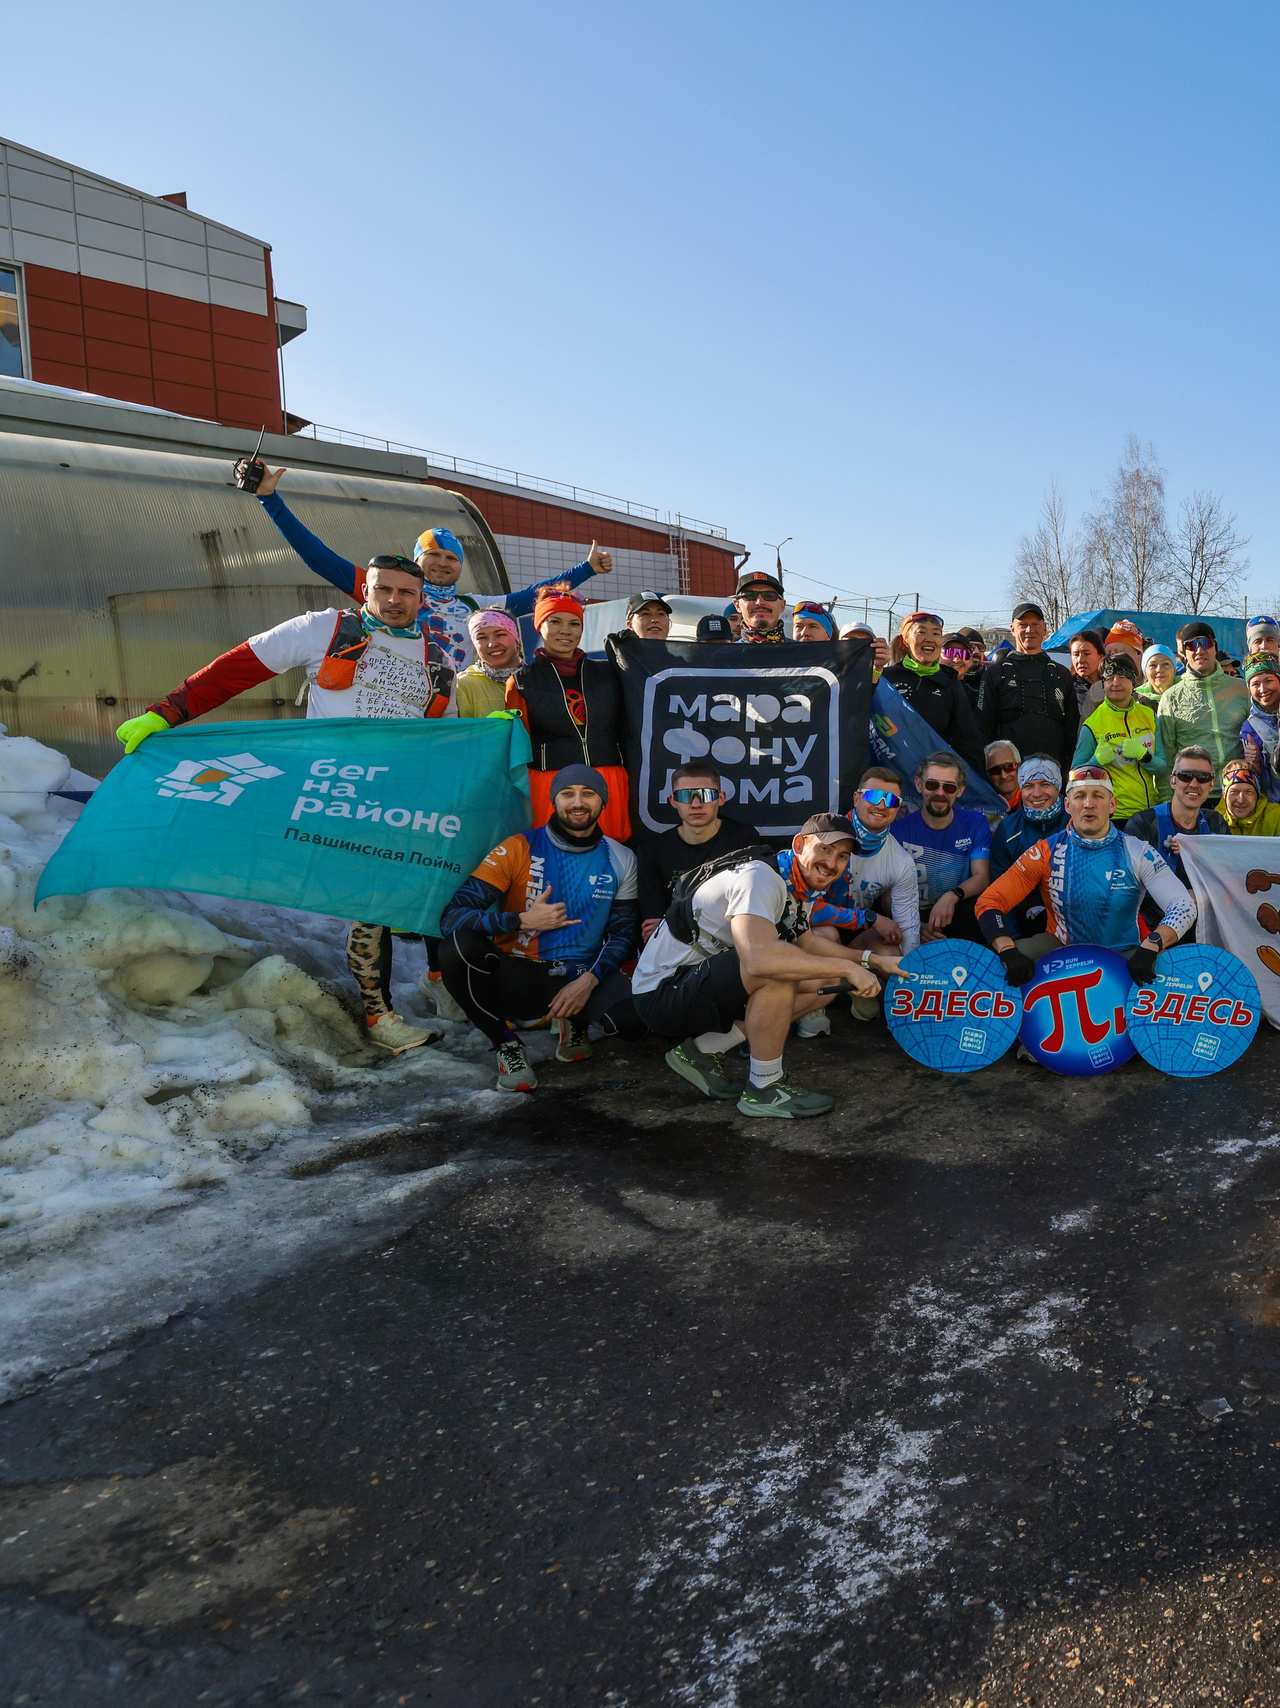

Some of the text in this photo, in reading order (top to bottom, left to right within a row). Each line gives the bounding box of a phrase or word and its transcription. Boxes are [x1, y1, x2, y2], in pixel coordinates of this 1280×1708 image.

[668, 694, 812, 733] мара
[662, 720, 819, 773] фону
[310, 758, 390, 782] бег
[301, 779, 358, 798] на
[290, 796, 462, 838] районе
[283, 827, 406, 862] Павшинская
[408, 851, 462, 874] Пойма
[1065, 957, 1079, 965] RUN
[1065, 959, 1094, 970] ZEPPELIN
[1164, 981, 1194, 990] ZEPPELIN
[890, 988, 1016, 1022] ЗДЕСЬ
[1132, 989, 1254, 1027] ЗДЕСЬ
[963, 1035, 983, 1045] фону
[964, 1030, 983, 1039] мара
[1199, 1035, 1217, 1045] мара
[962, 1041, 982, 1050] дома
[1195, 1046, 1214, 1056] дома
[1197, 1041, 1216, 1051] фону
